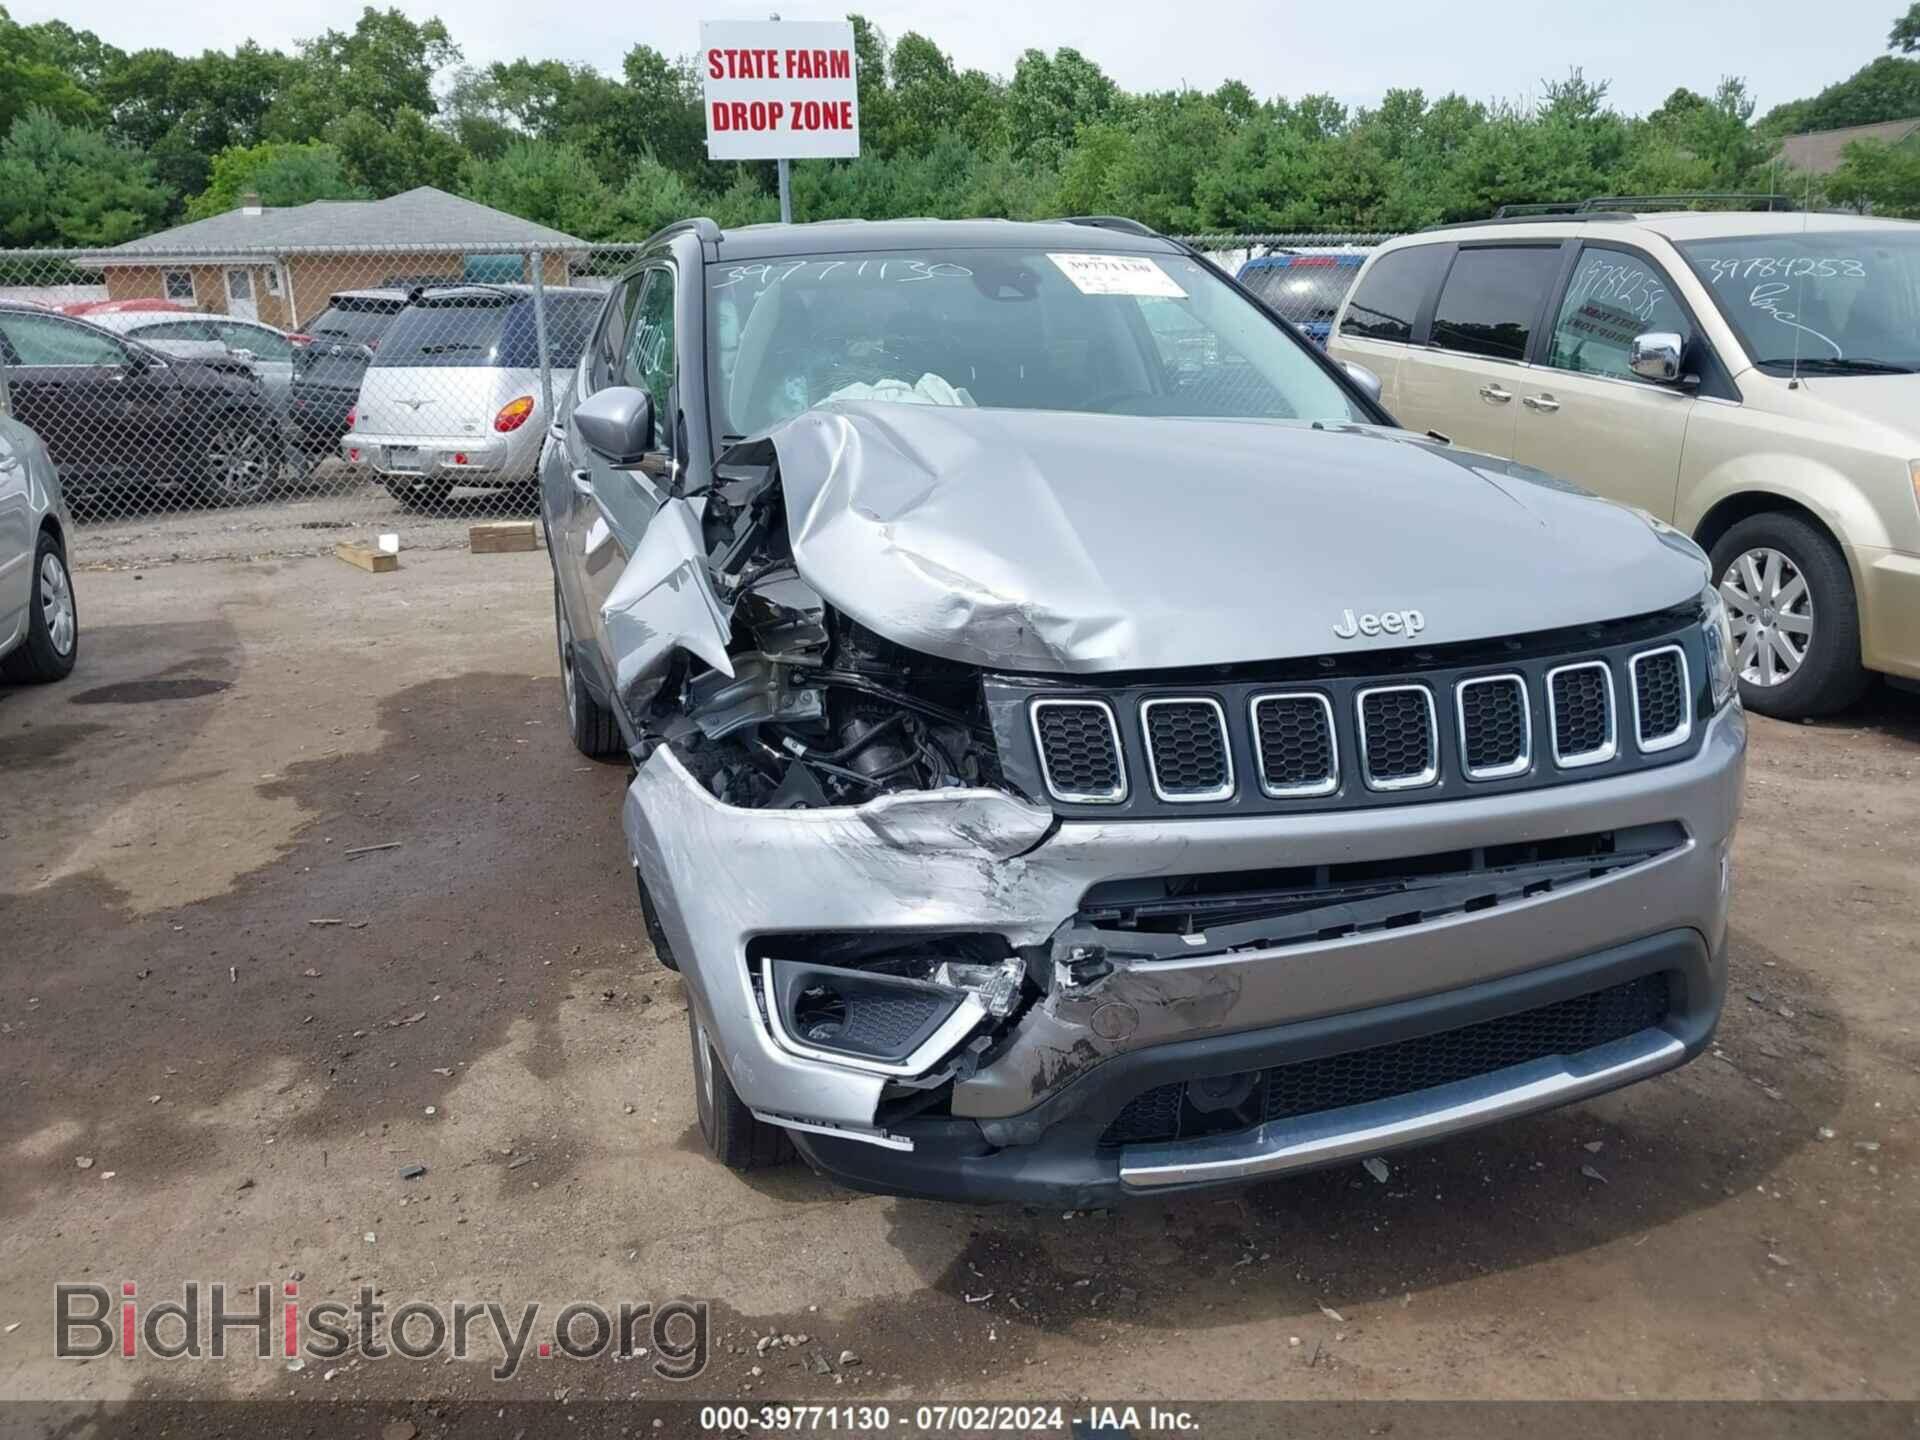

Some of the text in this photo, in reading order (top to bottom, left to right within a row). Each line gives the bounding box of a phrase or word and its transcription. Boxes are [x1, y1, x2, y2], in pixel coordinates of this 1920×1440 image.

[708, 48, 851, 79] STATE FARM
[712, 101, 853, 131] DROP ZONE
[712, 260, 974, 289] 39771130
[1694, 257, 1866, 284] 39784258
[1332, 608, 1425, 639] Jeep
